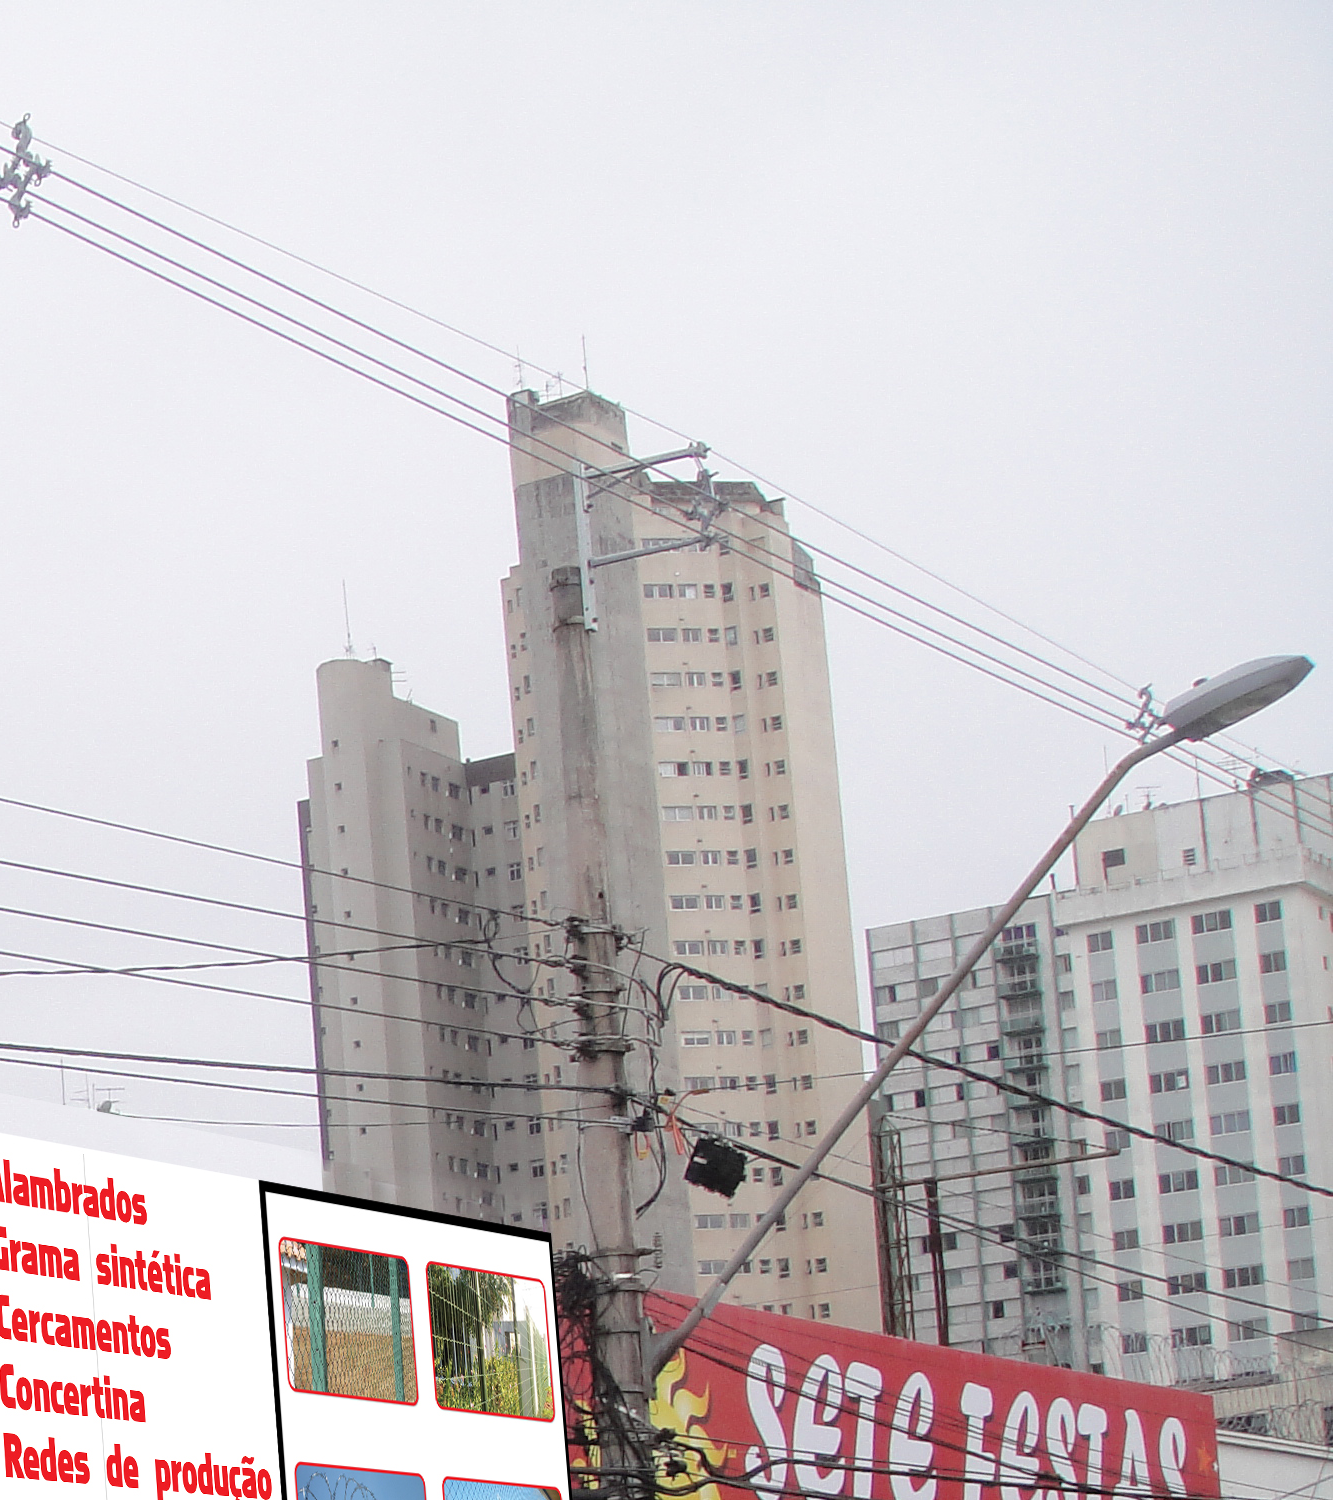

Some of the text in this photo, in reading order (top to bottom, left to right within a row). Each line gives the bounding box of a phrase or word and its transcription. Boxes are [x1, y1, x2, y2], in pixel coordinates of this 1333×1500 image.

[95, 1243, 212, 1301] sintética
[0, 1363, 147, 1423] Concertina
[3, 1433, 91, 1485] Redes
[106, 1443, 139, 1489] de
